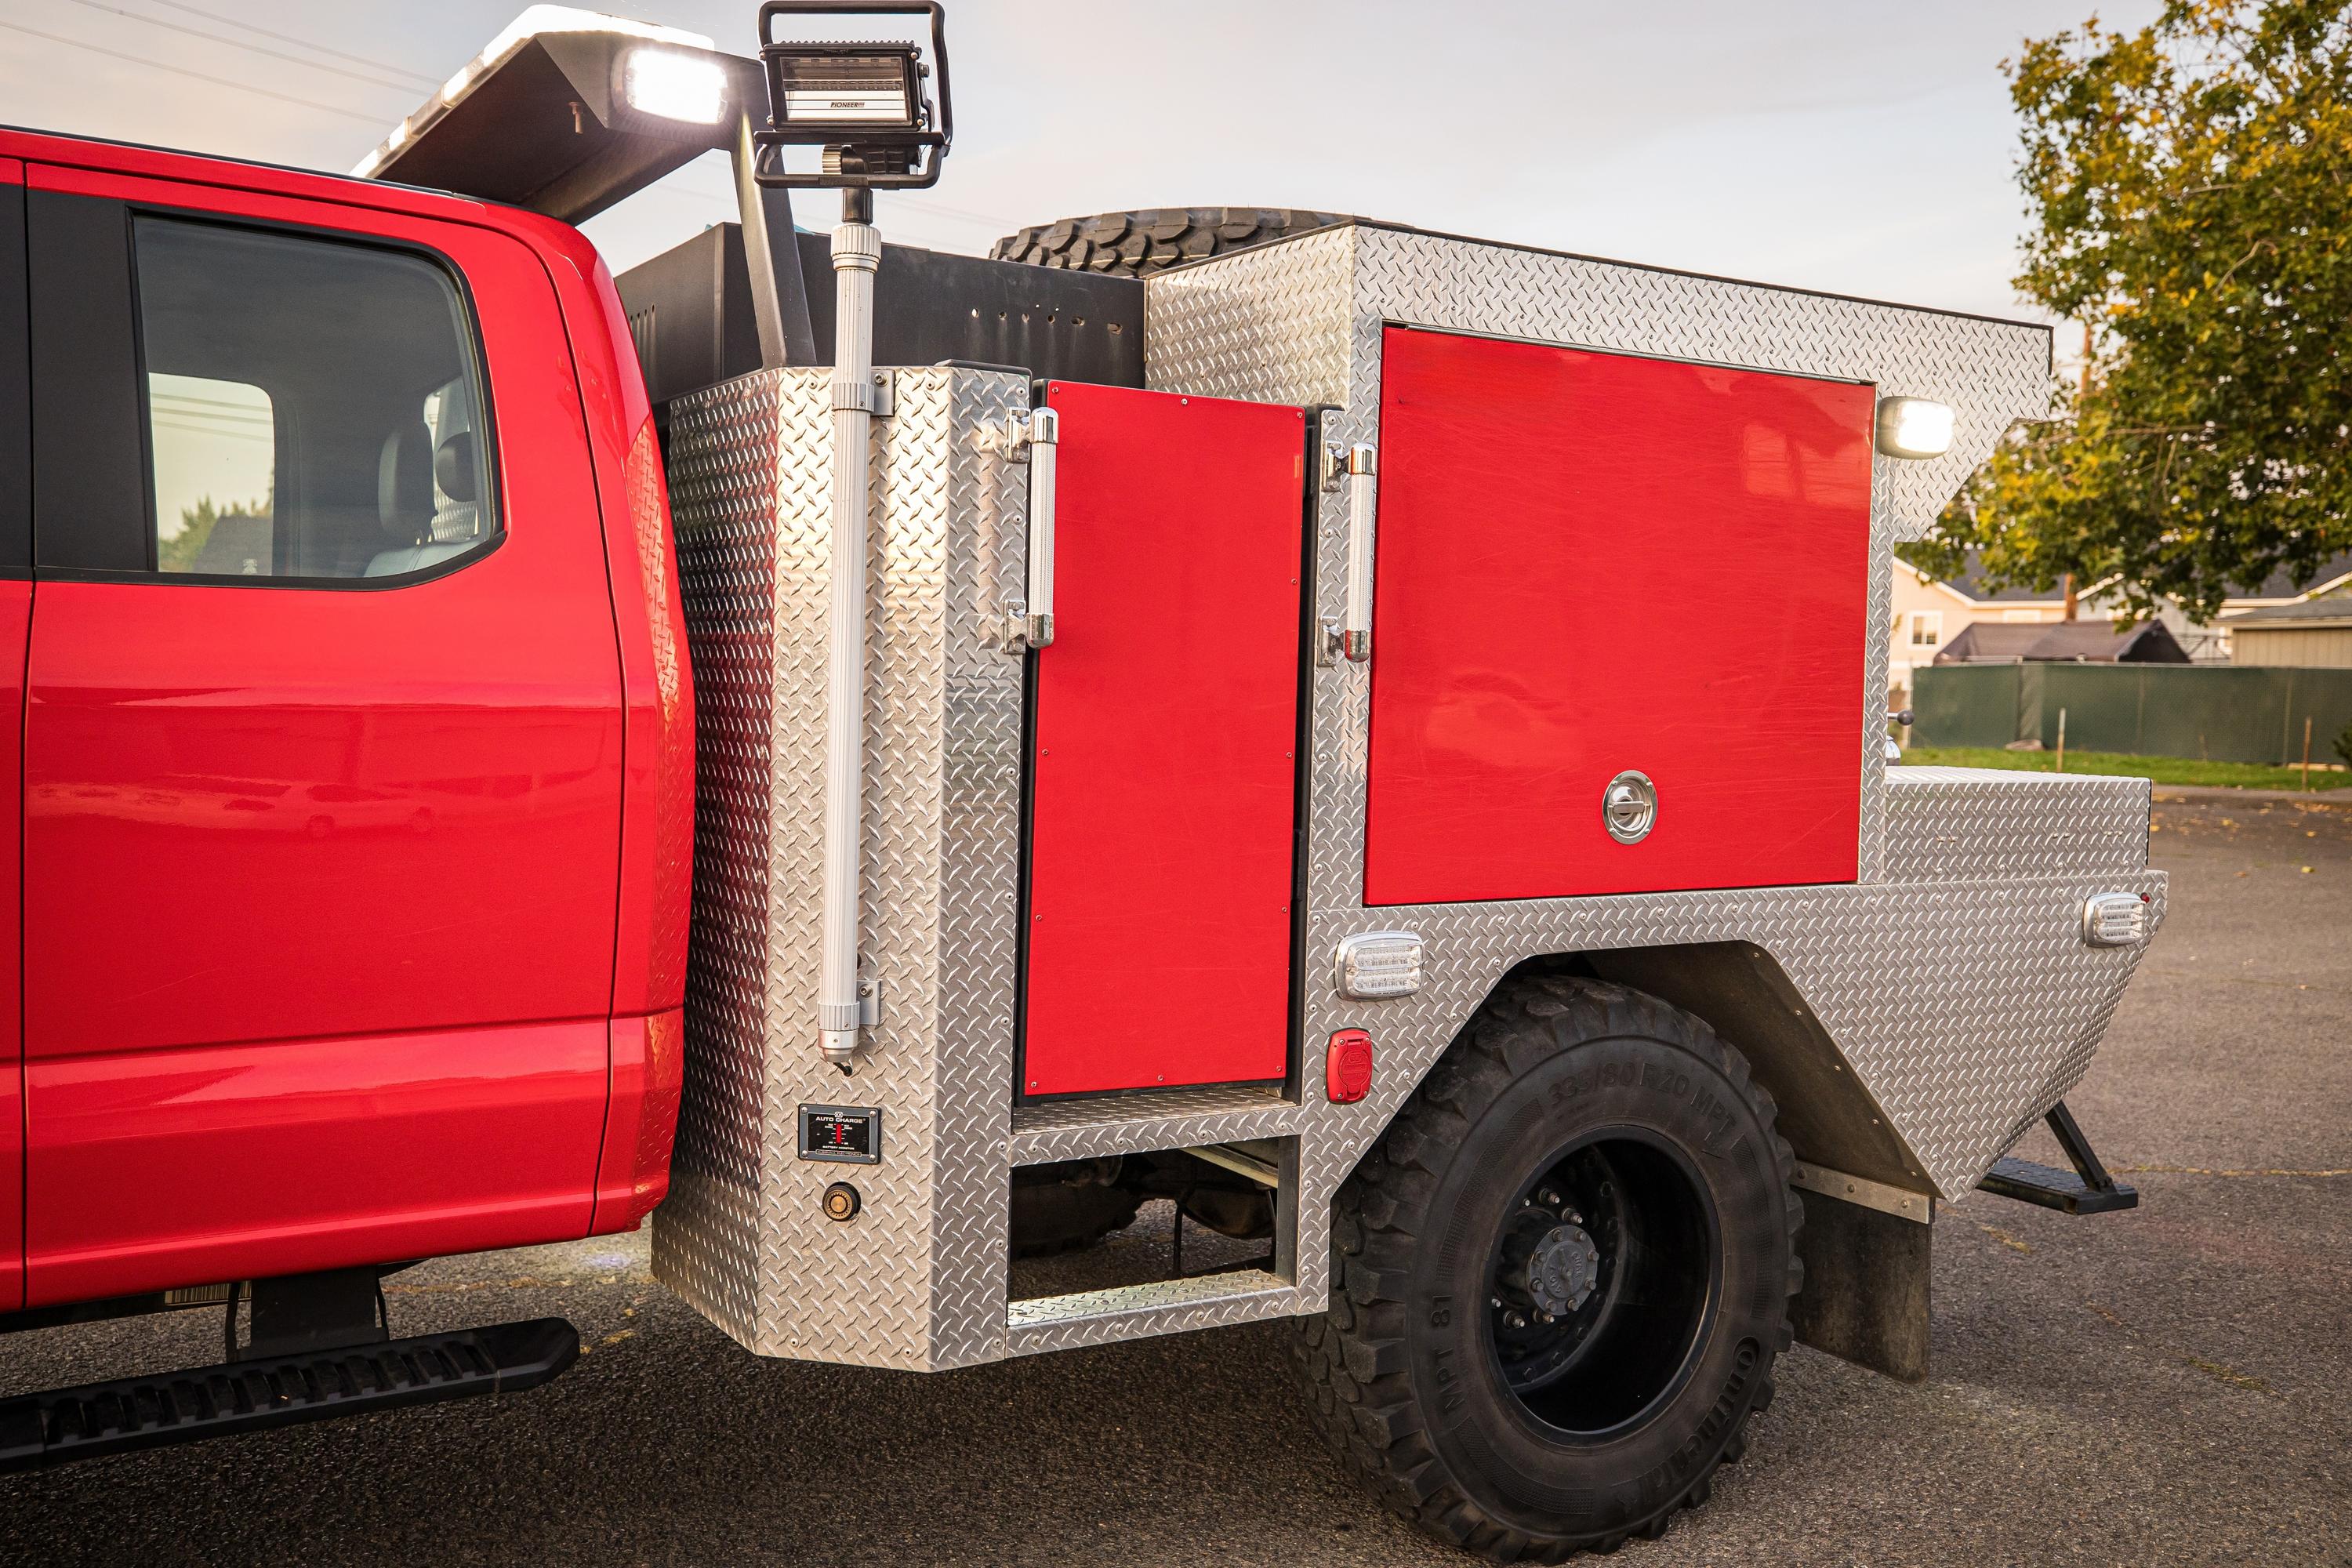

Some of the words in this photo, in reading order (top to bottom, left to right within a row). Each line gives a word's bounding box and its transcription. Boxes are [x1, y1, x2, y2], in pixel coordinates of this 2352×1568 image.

[1548, 1062, 1635, 1107] 335/80
[1639, 1061, 1690, 1098] R20
[1690, 1086, 1737, 1134] MPT
[1431, 1295, 1454, 1327] 81
[1433, 1347, 1465, 1415] MPT
[1638, 1335, 1761, 1504] Continental
